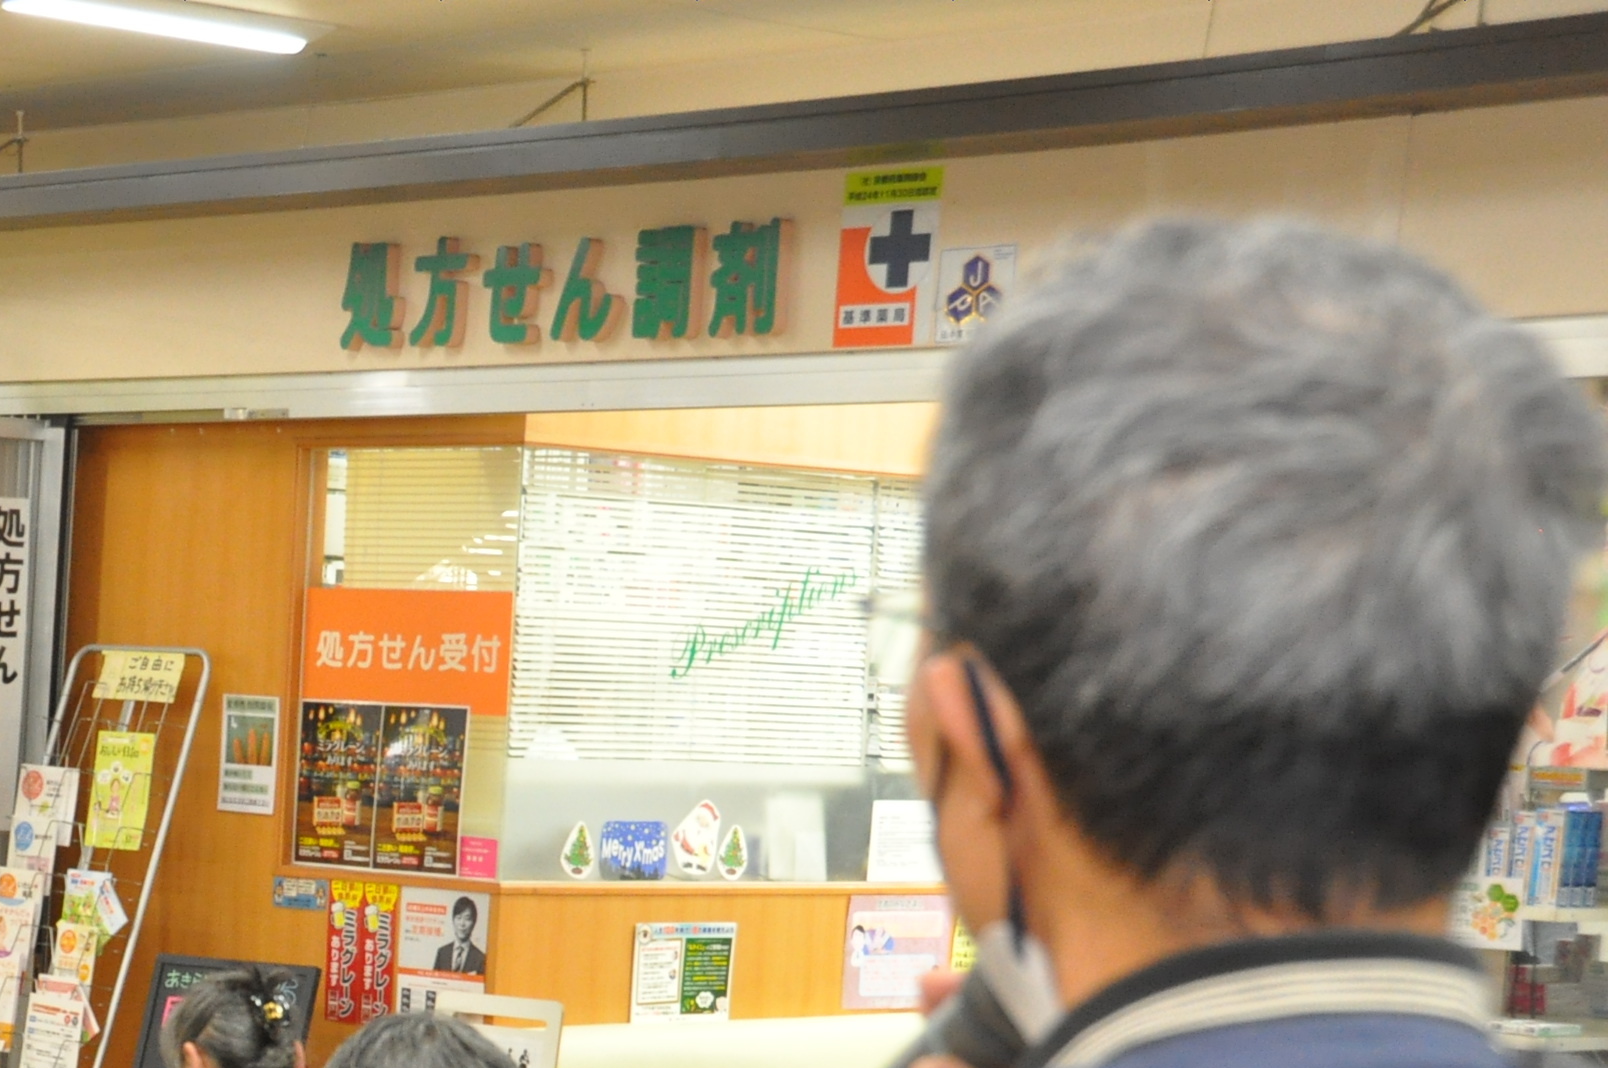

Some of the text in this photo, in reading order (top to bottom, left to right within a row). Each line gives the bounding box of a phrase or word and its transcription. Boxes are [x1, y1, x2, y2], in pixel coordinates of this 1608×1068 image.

[341, 216, 793, 350] 処方せん調剤
[843, 308, 906, 325] 基準薬局
[128, 655, 175, 672] ご自由に
[316, 630, 502, 674] 処方せん受付
[601, 838, 665, 867] Merry X'mas
[164, 969, 207, 988] あきら
[330, 935, 340, 987] あります
[340, 909, 356, 1017] ミラグレーン
[363, 939, 374, 991] あります
[374, 913, 391, 1018] ミラグレーン
